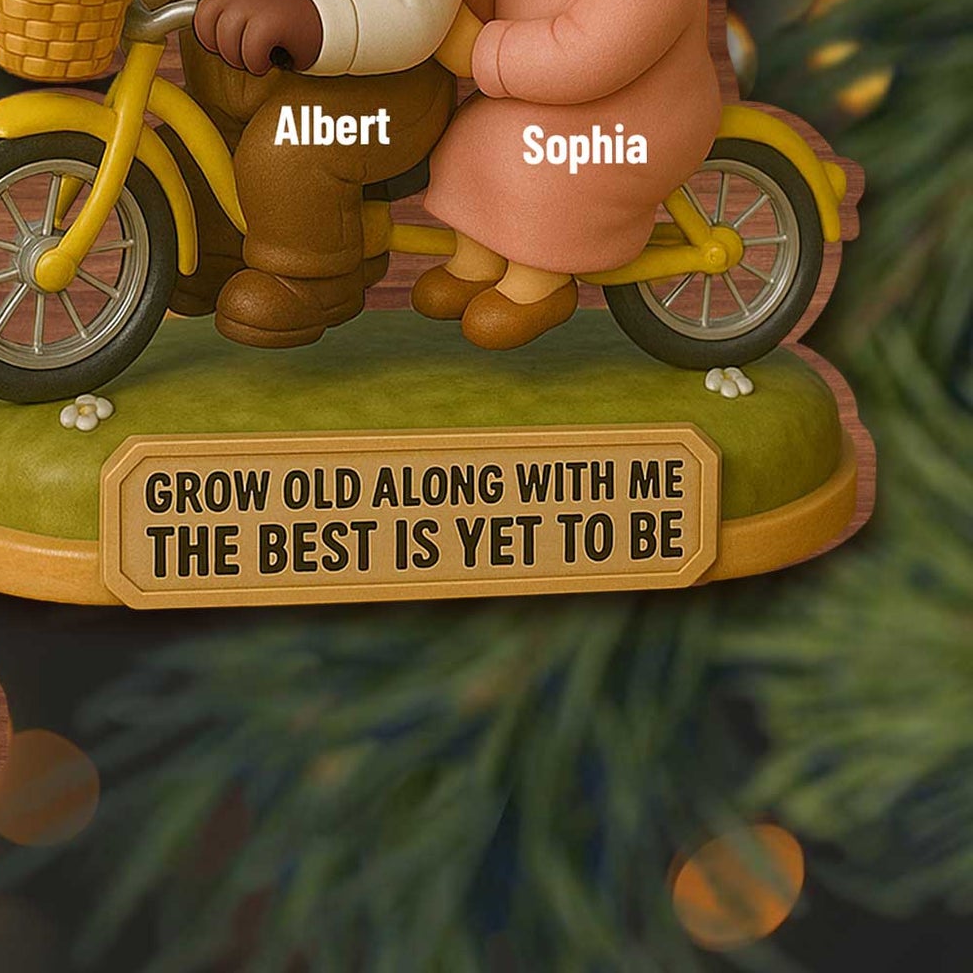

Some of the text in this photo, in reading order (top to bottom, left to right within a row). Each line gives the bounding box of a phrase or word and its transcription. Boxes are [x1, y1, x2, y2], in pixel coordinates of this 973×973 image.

[273, 106, 391, 146] Albert
[522, 123, 648, 174] Sophia
[145, 460, 684, 514] GROW OLD ALONG WITH ME
[146, 510, 684, 578] THE BEST IS YET TO BE
